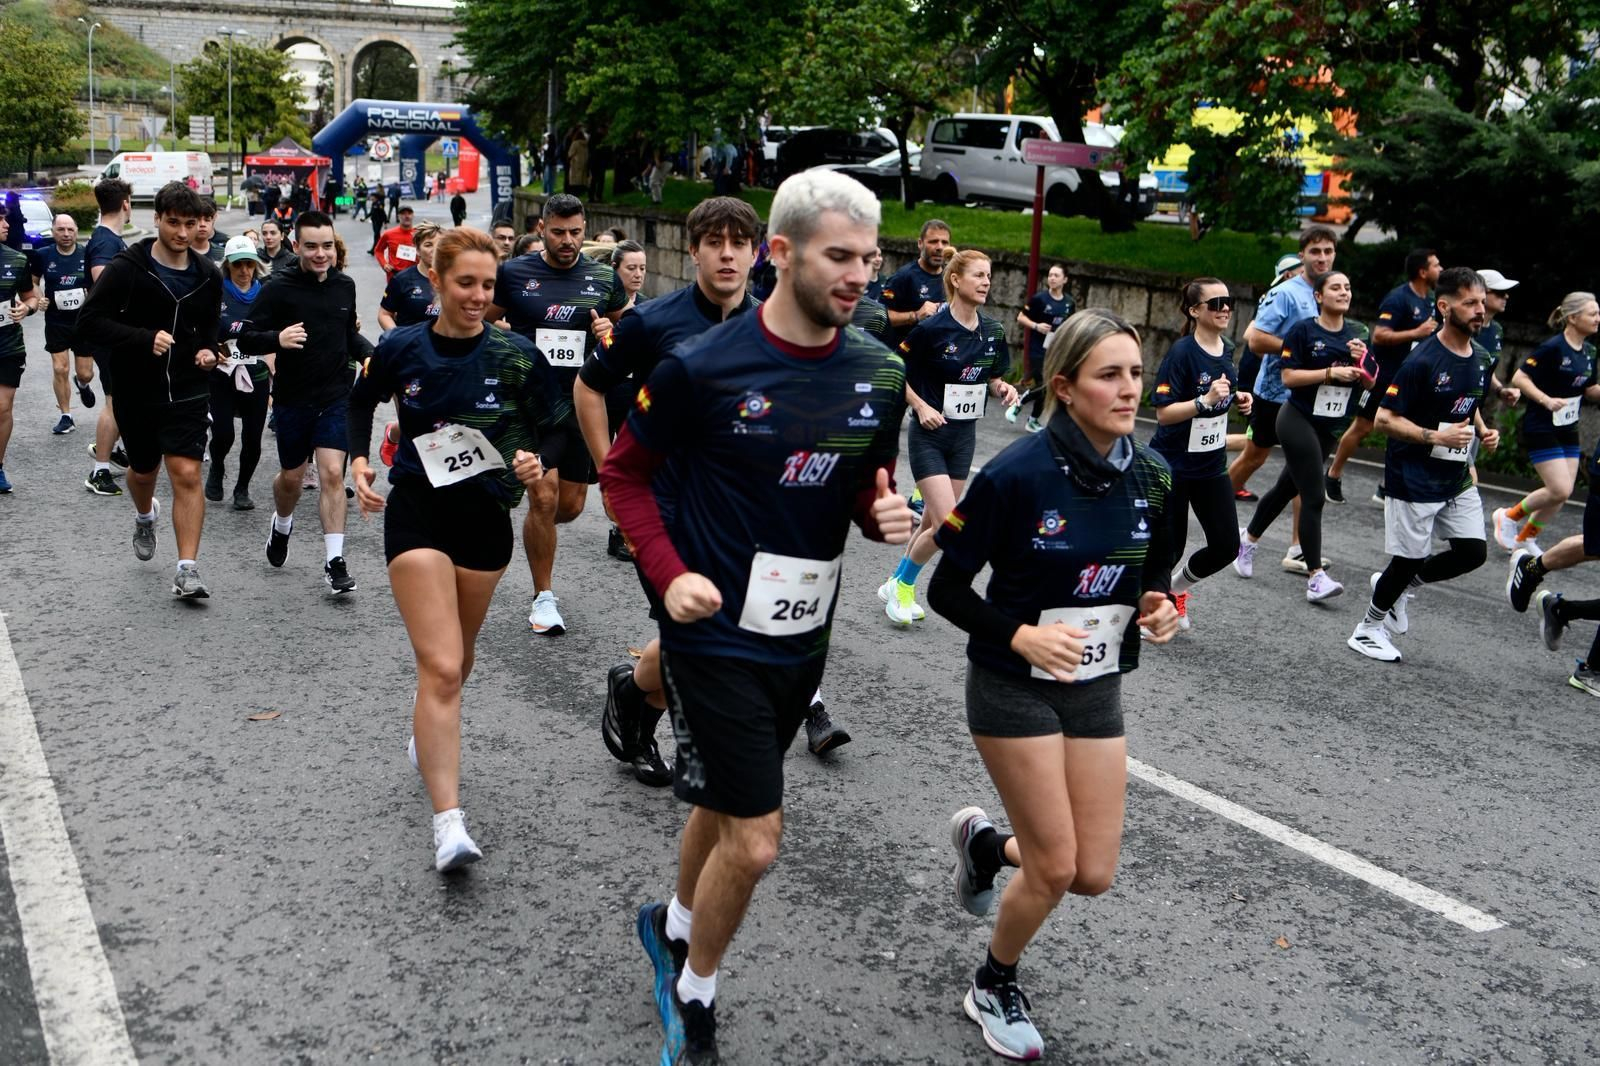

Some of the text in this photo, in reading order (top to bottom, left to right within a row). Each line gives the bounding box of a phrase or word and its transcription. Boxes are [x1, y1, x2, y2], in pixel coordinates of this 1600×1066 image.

[367, 107, 441, 120] POLICIA
[368, 118, 461, 131] NACIONAL
[548, 348, 575, 360] 189
[955, 402, 976, 414] 101
[1200, 432, 1219, 446] 581
[444, 446, 486, 473] 251
[797, 452, 841, 482] 091
[1089, 564, 1127, 594] 091
[770, 597, 821, 621] 264
[1080, 643, 1108, 665] 63
